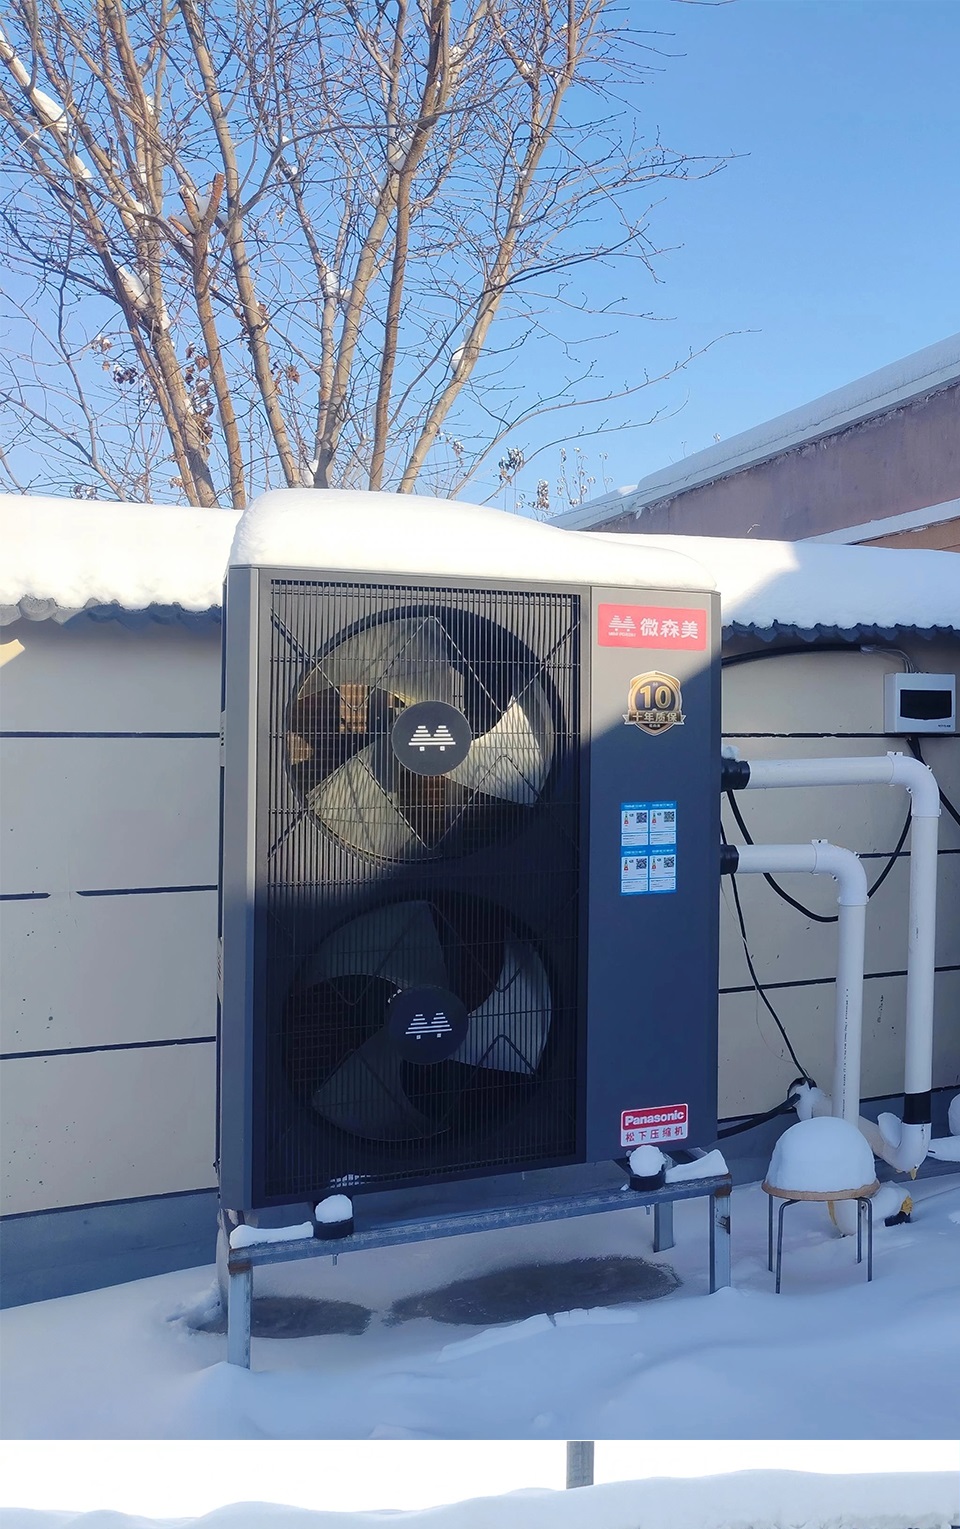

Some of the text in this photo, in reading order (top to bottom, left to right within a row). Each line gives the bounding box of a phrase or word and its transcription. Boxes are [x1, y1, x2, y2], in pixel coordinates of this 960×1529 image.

[640, 617, 699, 640] 微森美
[639, 685, 672, 709] 10
[632, 711, 678, 722] 十年质保
[624, 1109, 685, 1127] Panasonic
[625, 1126, 684, 1142] 松下压缩机
